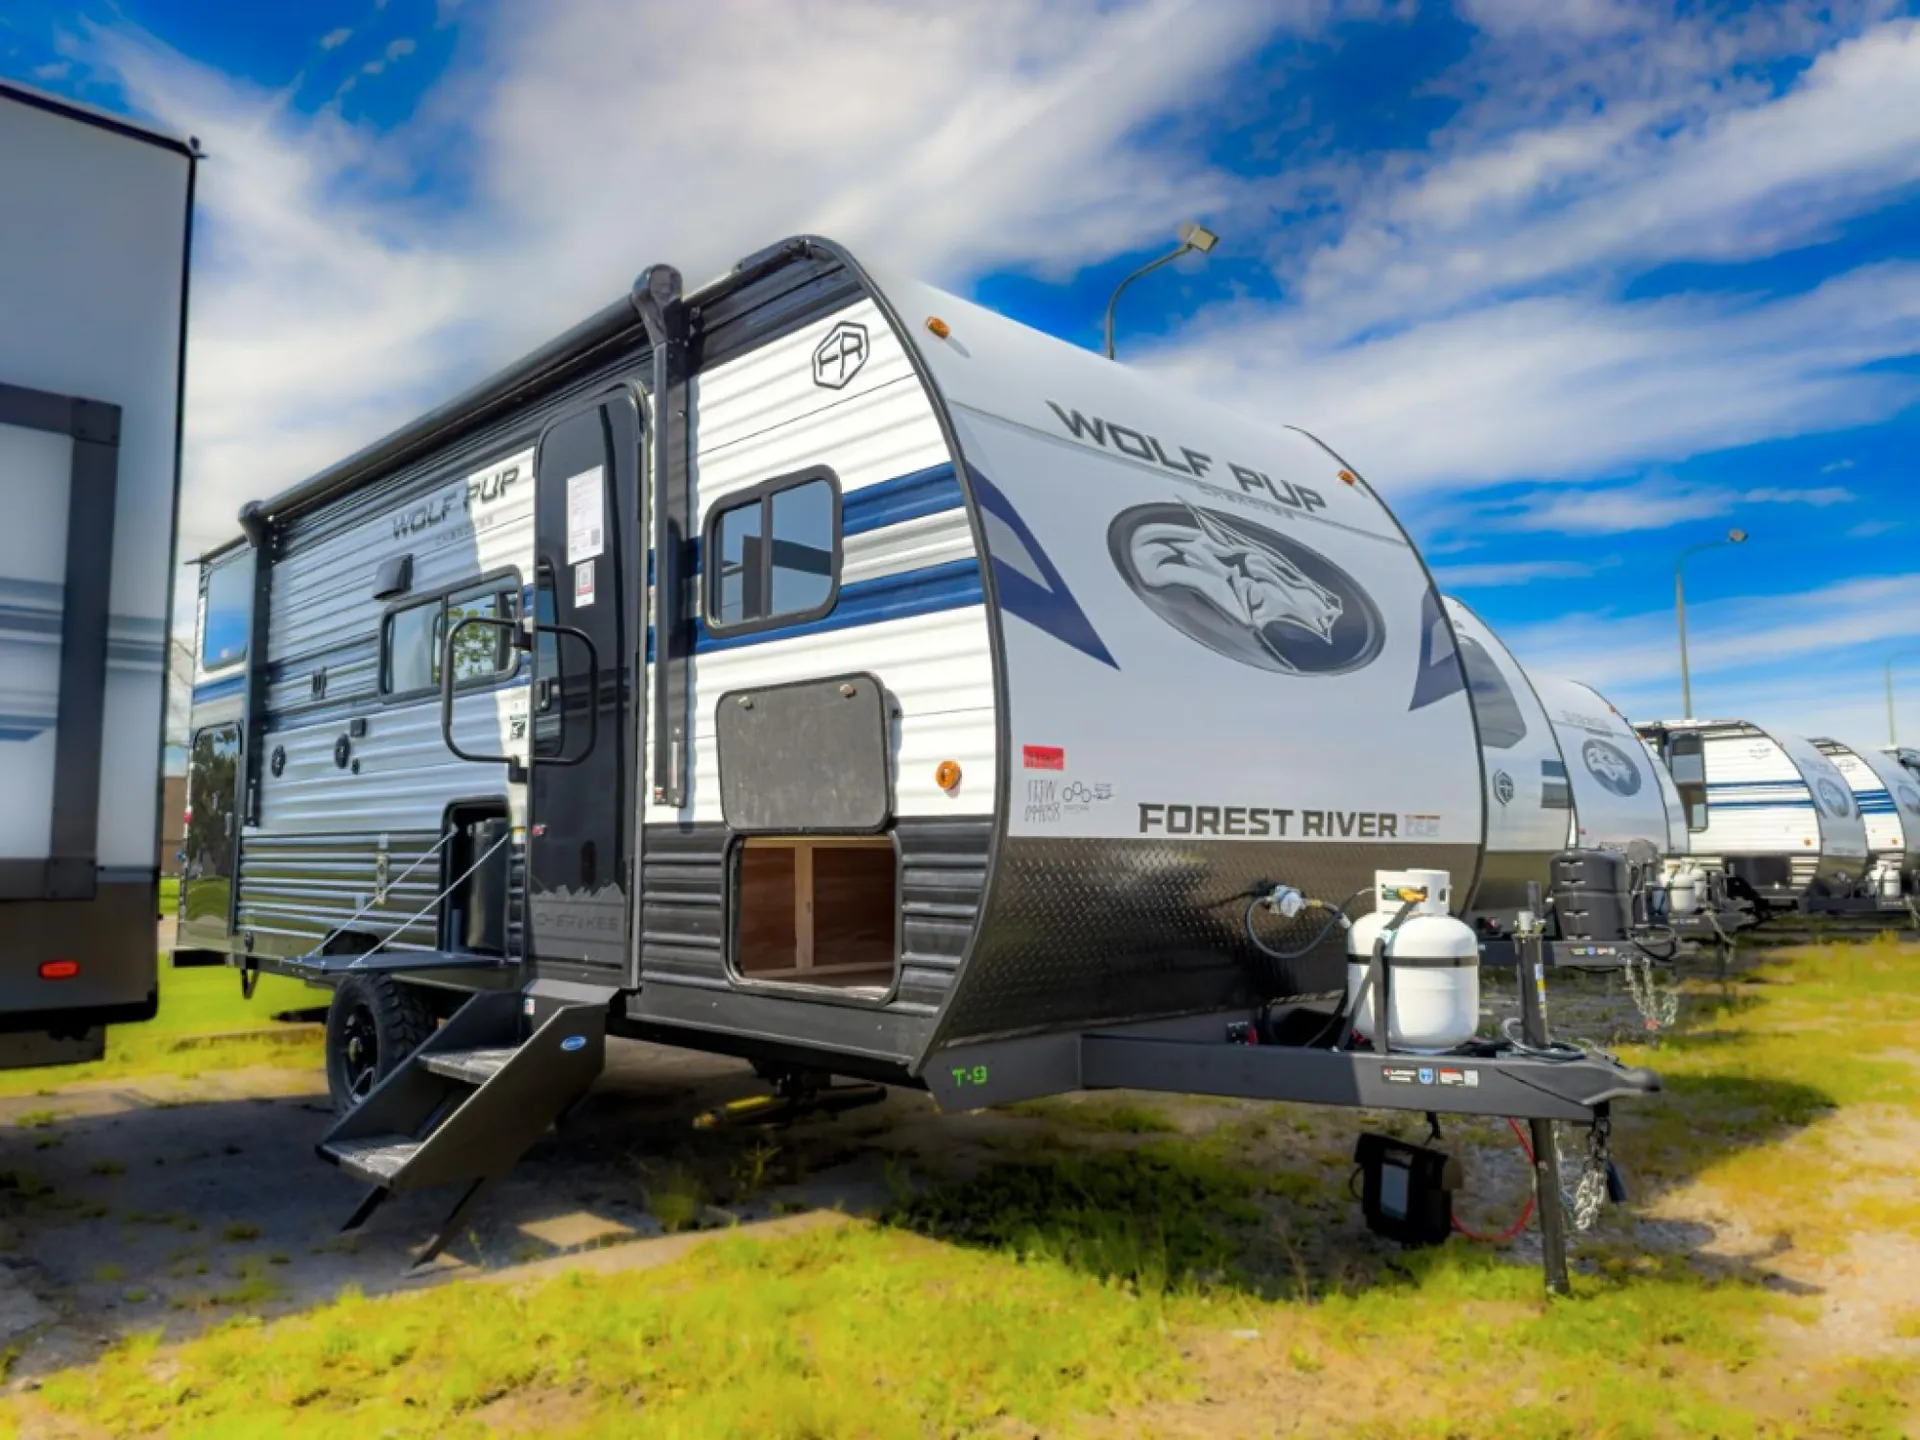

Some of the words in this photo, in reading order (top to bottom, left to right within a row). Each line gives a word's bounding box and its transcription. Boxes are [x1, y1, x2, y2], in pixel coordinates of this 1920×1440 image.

[1045, 399, 1213, 478] WOLF
[1227, 462, 1326, 513] PUP
[393, 490, 458, 540] WOLF
[463, 465, 519, 513] PUP
[1138, 803, 1294, 836] FOREST
[1302, 810, 1398, 838] RIVER
